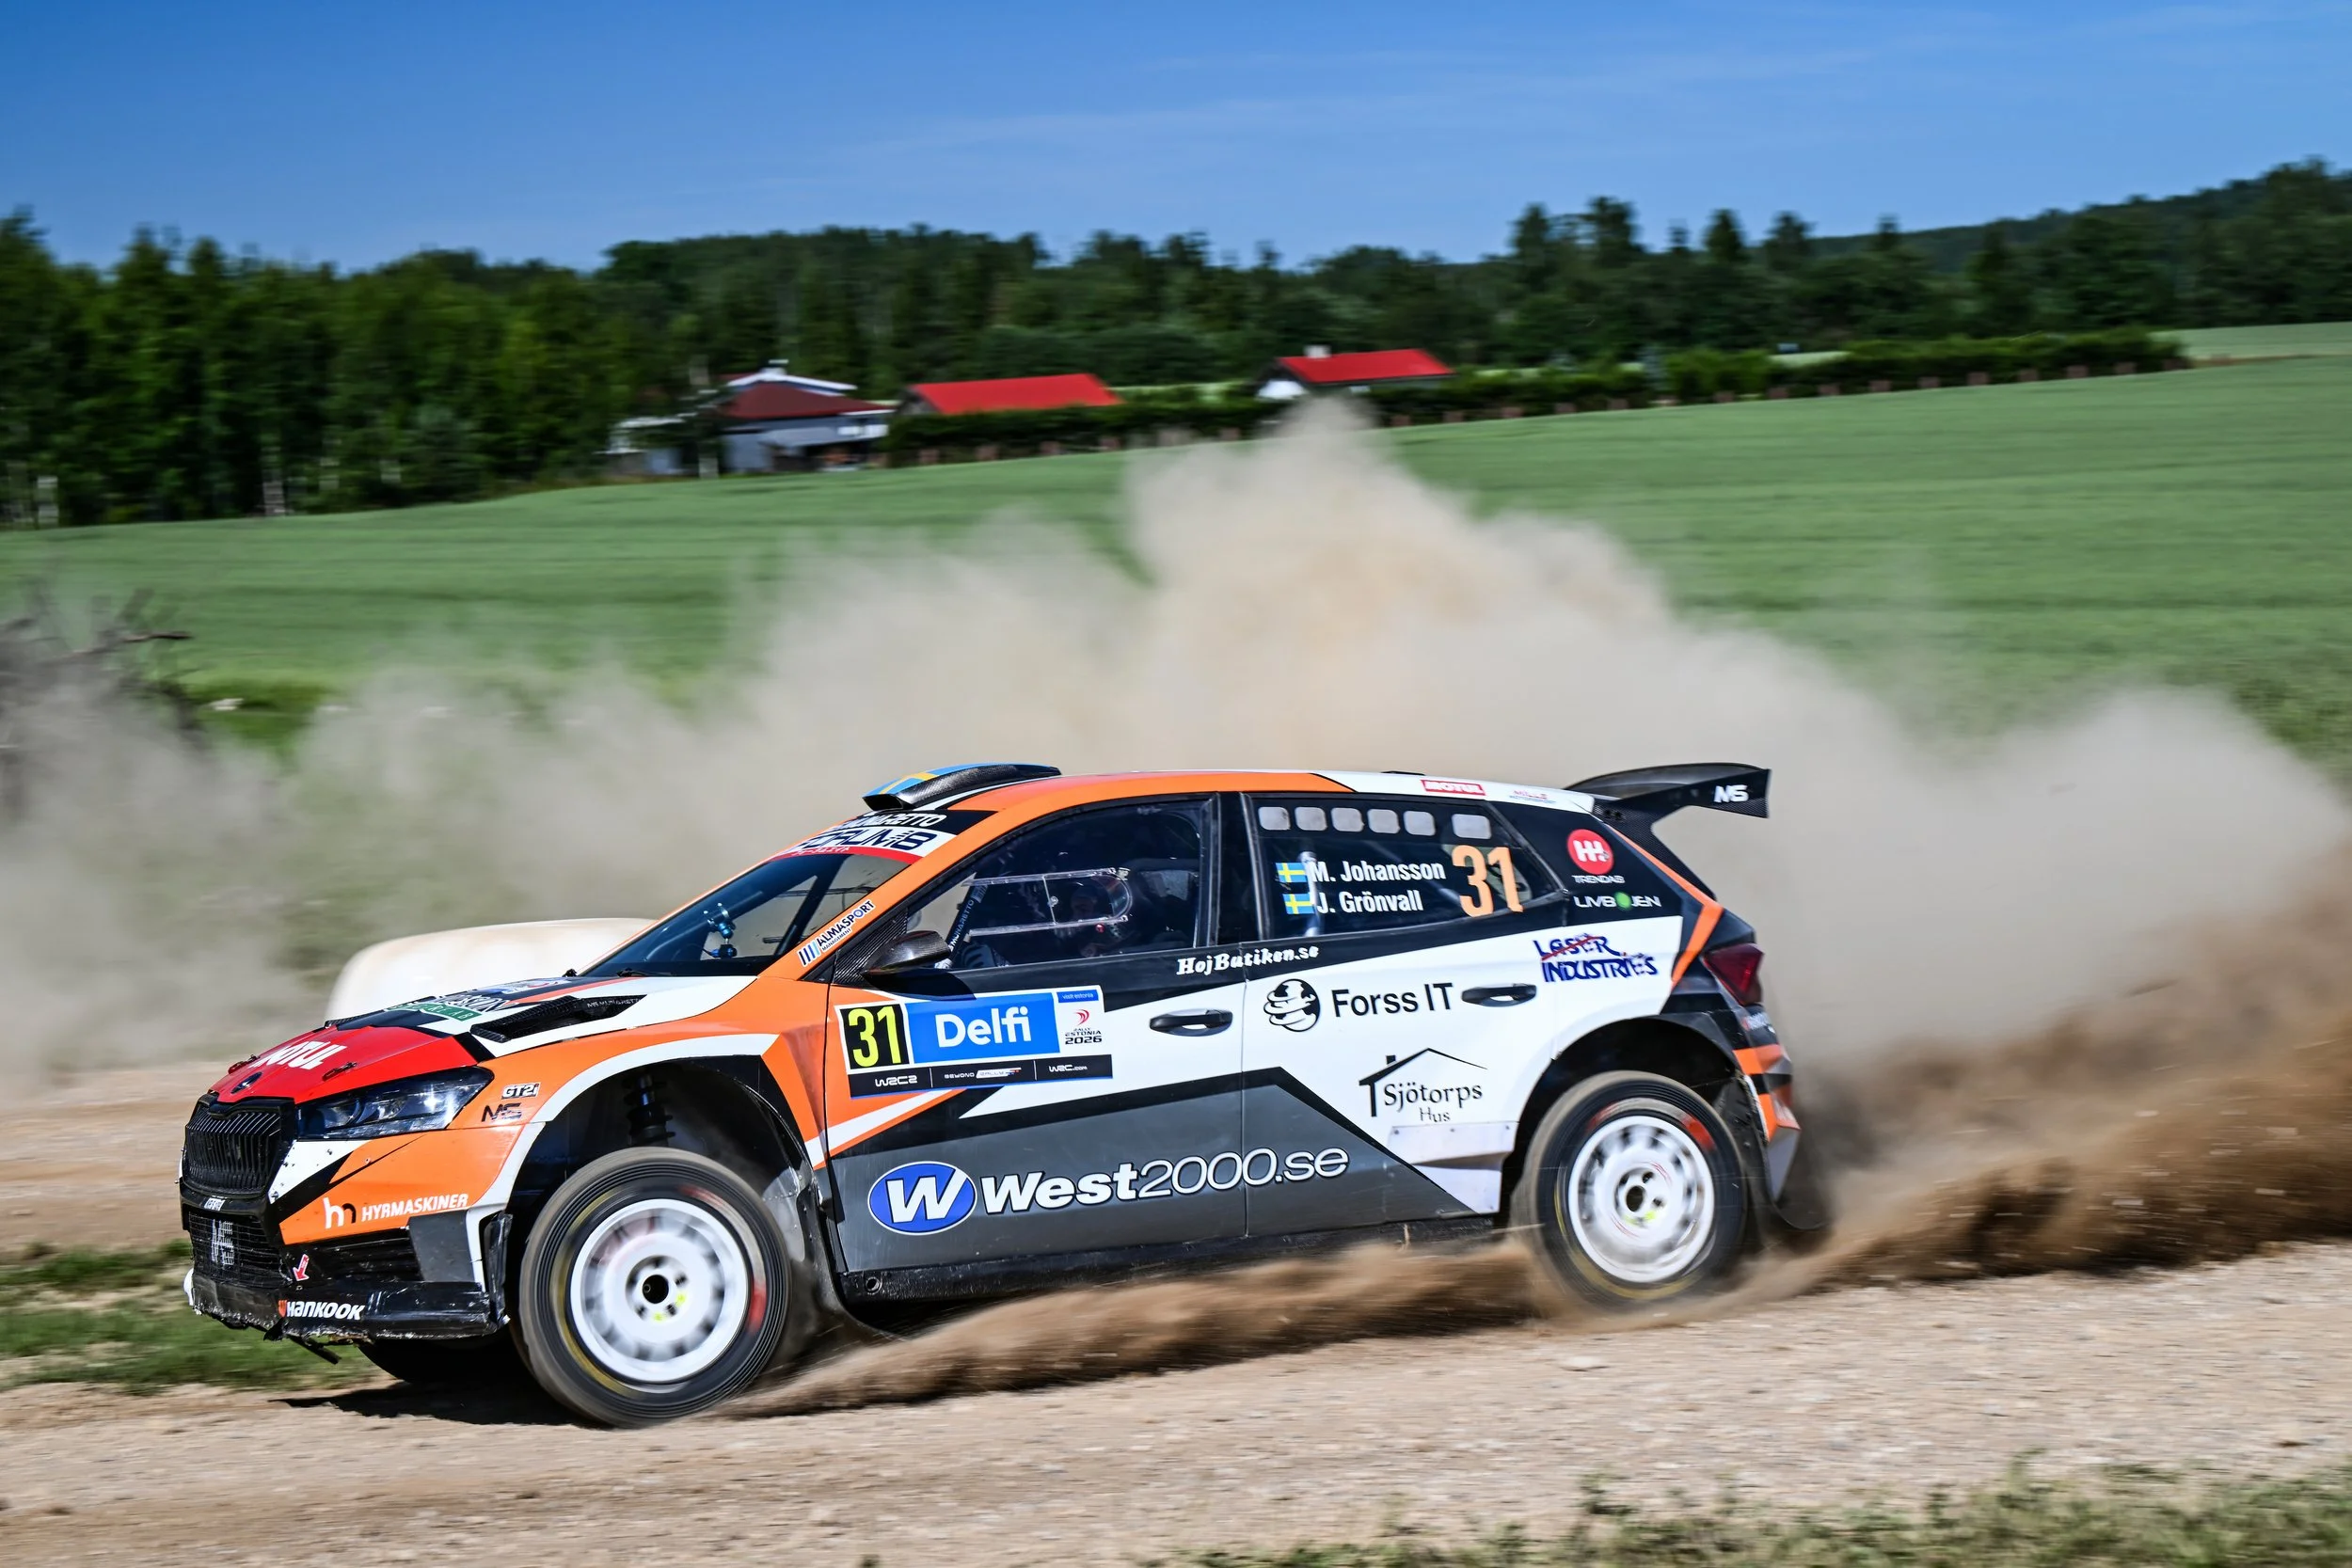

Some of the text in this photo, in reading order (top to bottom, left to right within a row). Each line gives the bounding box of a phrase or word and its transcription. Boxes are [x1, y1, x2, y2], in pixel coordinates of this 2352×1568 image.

[1311, 861, 1446, 882] M. Johansson
[1452, 845, 1524, 918] 31
[1316, 890, 1424, 913] J. Grönvall
[817, 900, 874, 946] ALMASPORT
[1331, 982, 1454, 1018] Forss IT
[848, 1006, 901, 1068] 31
[935, 1006, 1031, 1048] Delfi
[1065, 1036, 1103, 1045] 2026
[875, 1075, 918, 1087] WRC2
[1383, 1082, 1484, 1113] Sjötorps
[1419, 1107, 1452, 1123] Hus
[980, 1147, 1350, 1213] West2000.se
[361, 1193, 469, 1222] HYRMASKINER
